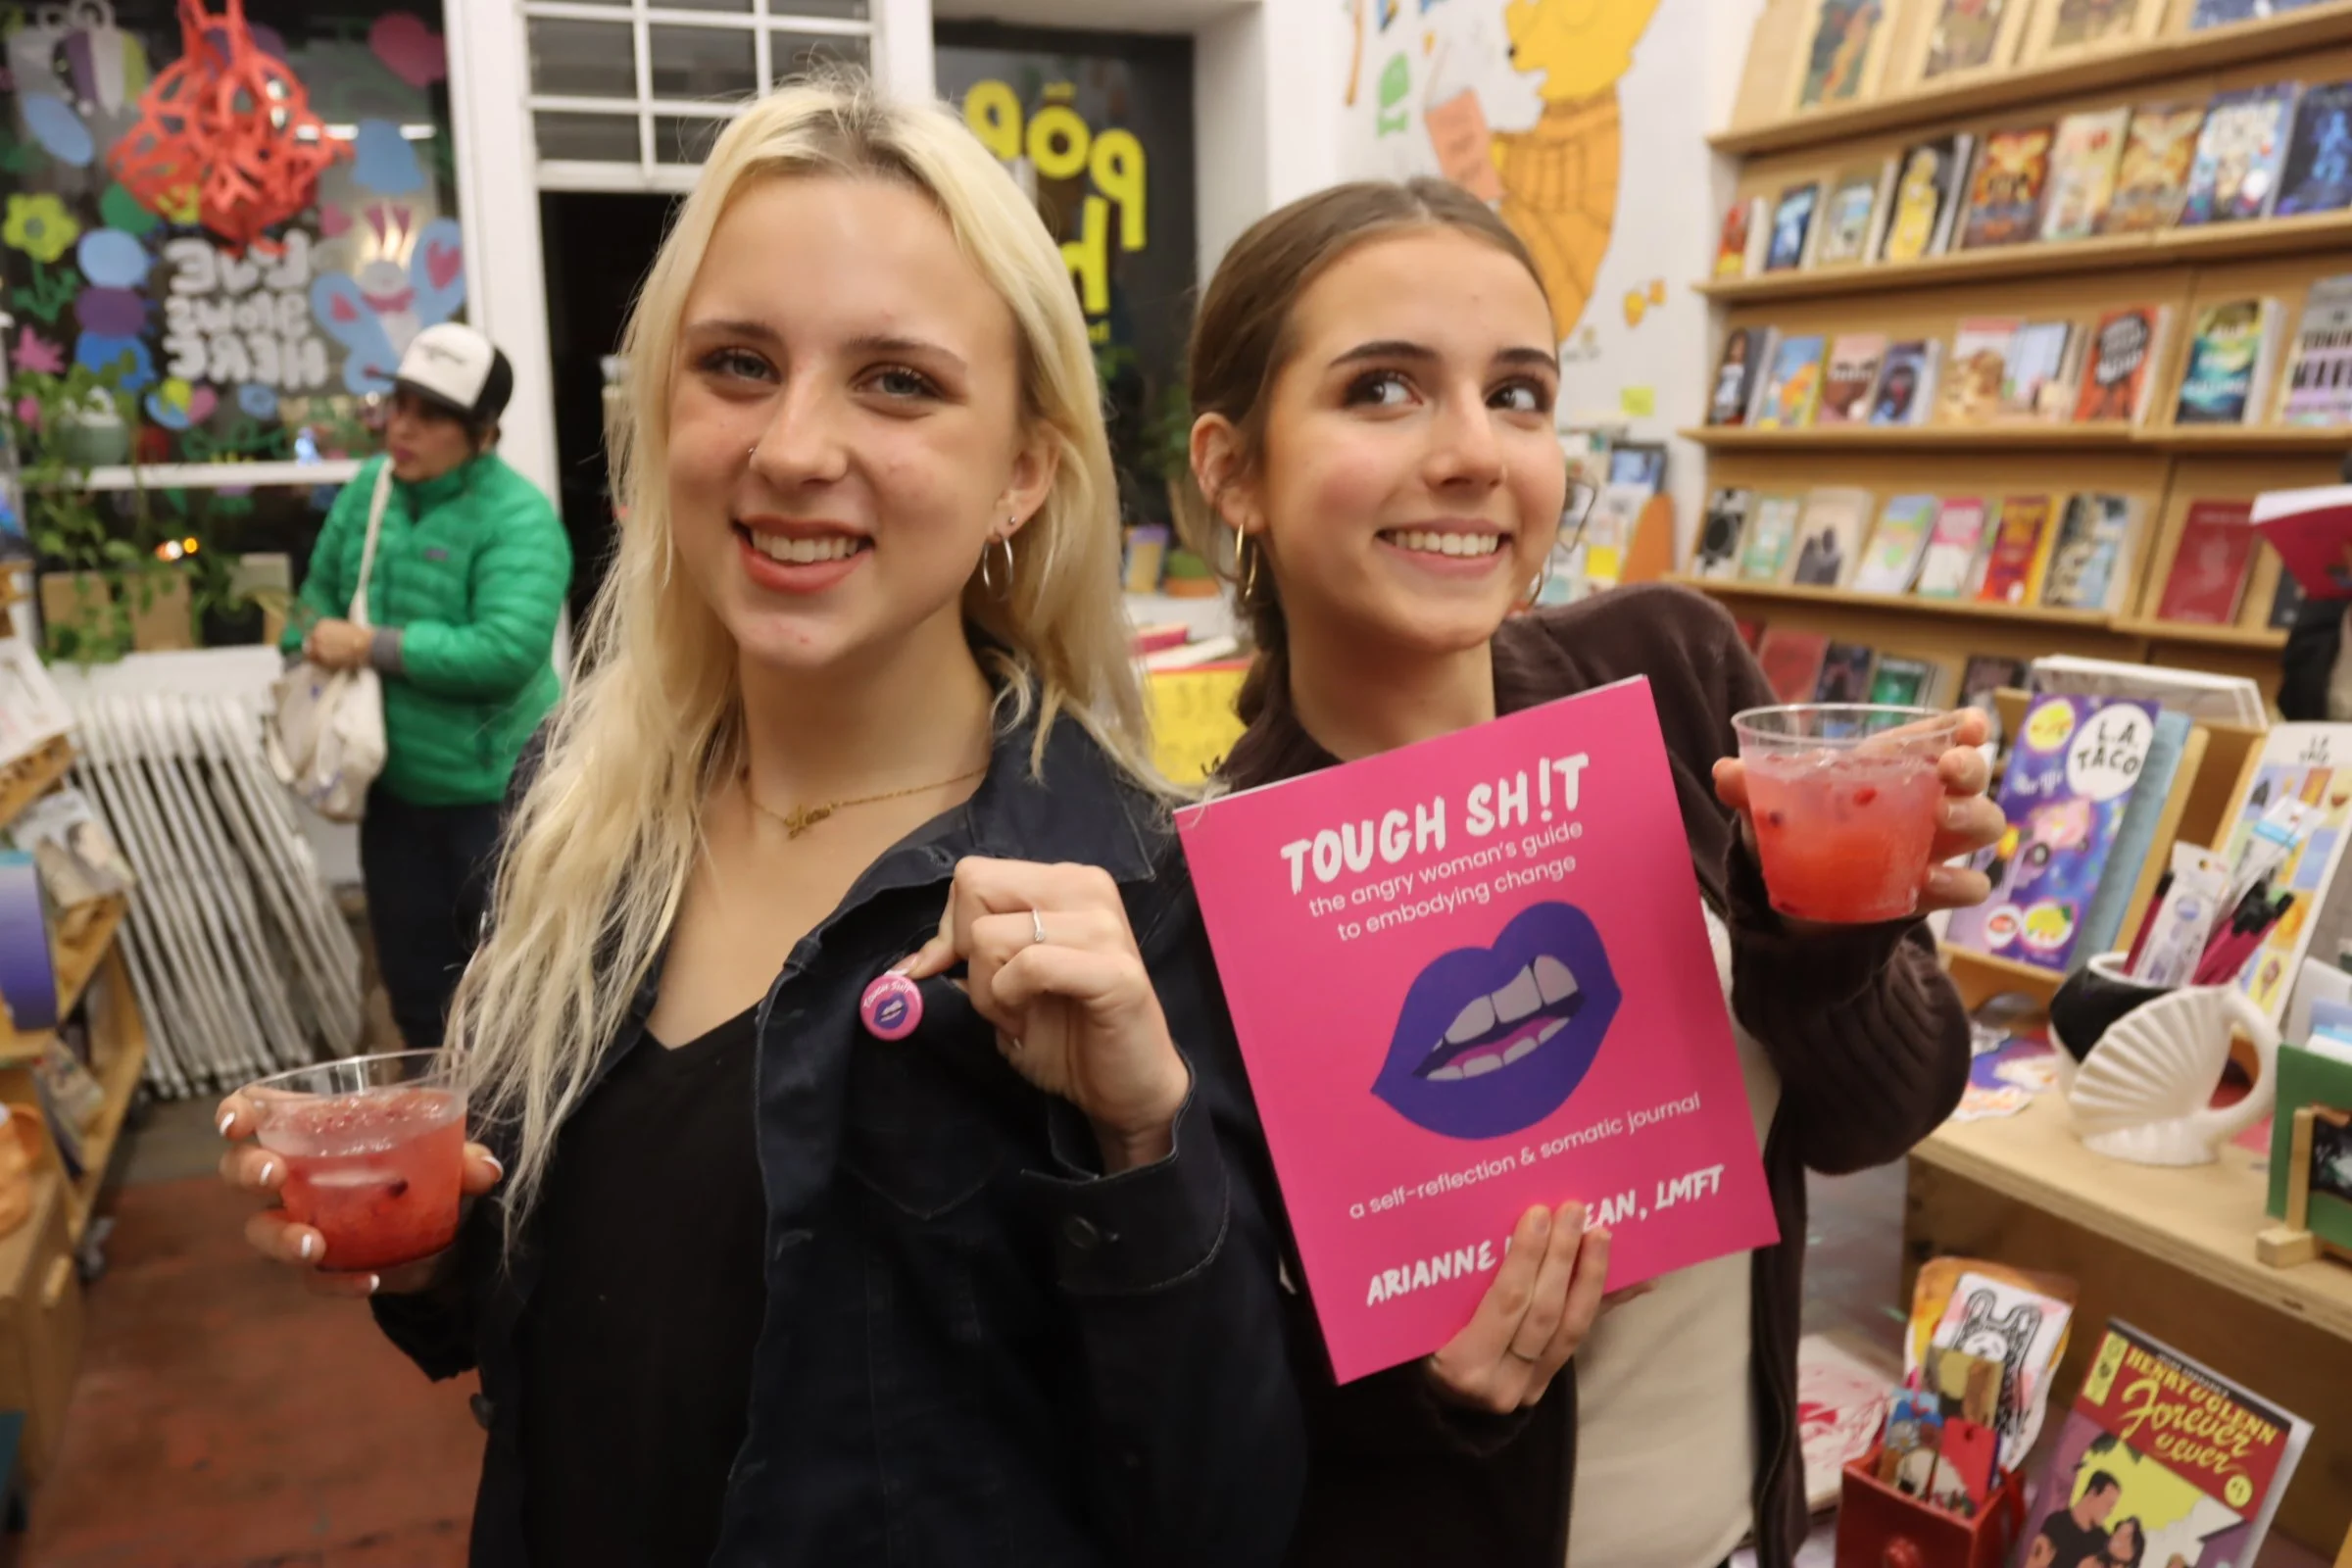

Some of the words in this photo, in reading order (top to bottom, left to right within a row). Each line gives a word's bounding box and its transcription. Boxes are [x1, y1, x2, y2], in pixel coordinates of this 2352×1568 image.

[2077, 746, 2140, 775] TACO
[1280, 795, 1446, 896] TOUGH
[1465, 752, 1590, 838] SH!T
[1309, 893, 1346, 917] the
[1351, 872, 1415, 906] angry
[1419, 841, 1517, 886] woman's
[1522, 820, 1584, 858] guide
[1338, 918, 1361, 941] to
[1366, 881, 1491, 934] embodying
[1494, 855, 1577, 894] change
[1349, 1201, 1365, 1219] a
[1370, 1155, 1516, 1214] self-reflection
[1520, 1147, 1536, 1165] &
[1540, 1118, 1624, 1158] somatic
[1627, 1092, 1700, 1135] journal
[1365, 1239, 1497, 1307] ARIANNE
[1654, 1163, 1725, 1211] LMFT
[2117, 1376, 2253, 1457] Forever
[2126, 1346, 2190, 1396] HENRY
